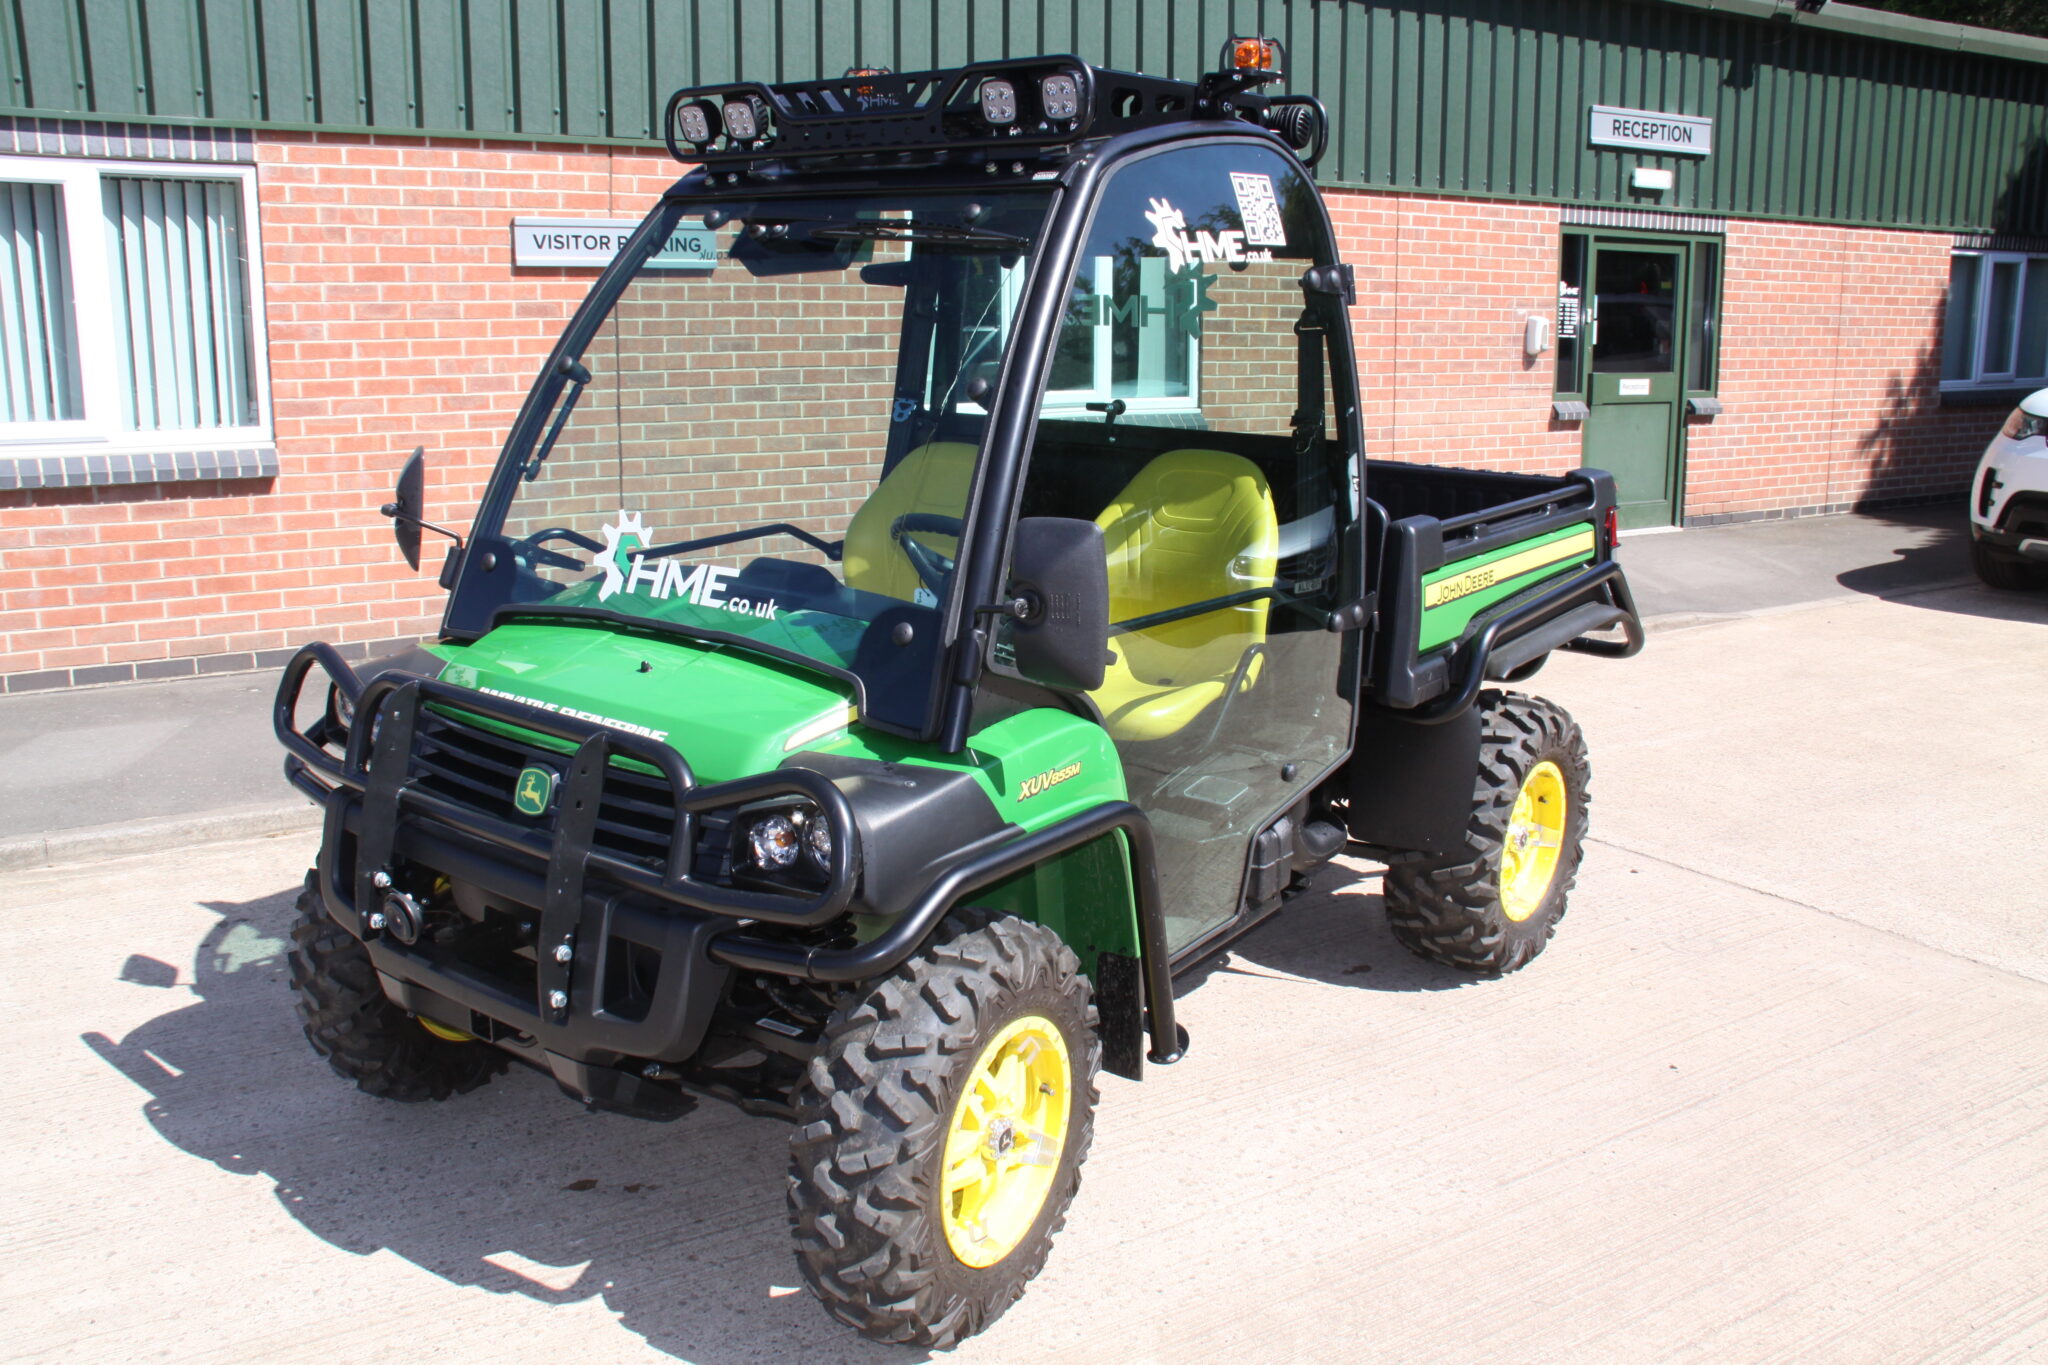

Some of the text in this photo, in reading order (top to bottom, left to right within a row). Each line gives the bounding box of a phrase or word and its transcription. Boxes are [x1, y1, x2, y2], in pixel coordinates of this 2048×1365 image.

[1612, 119, 1692, 143] RECEPTION
[533, 234, 701, 252] VISITOR PING
[1437, 569, 1495, 602] JOHN DEERE
